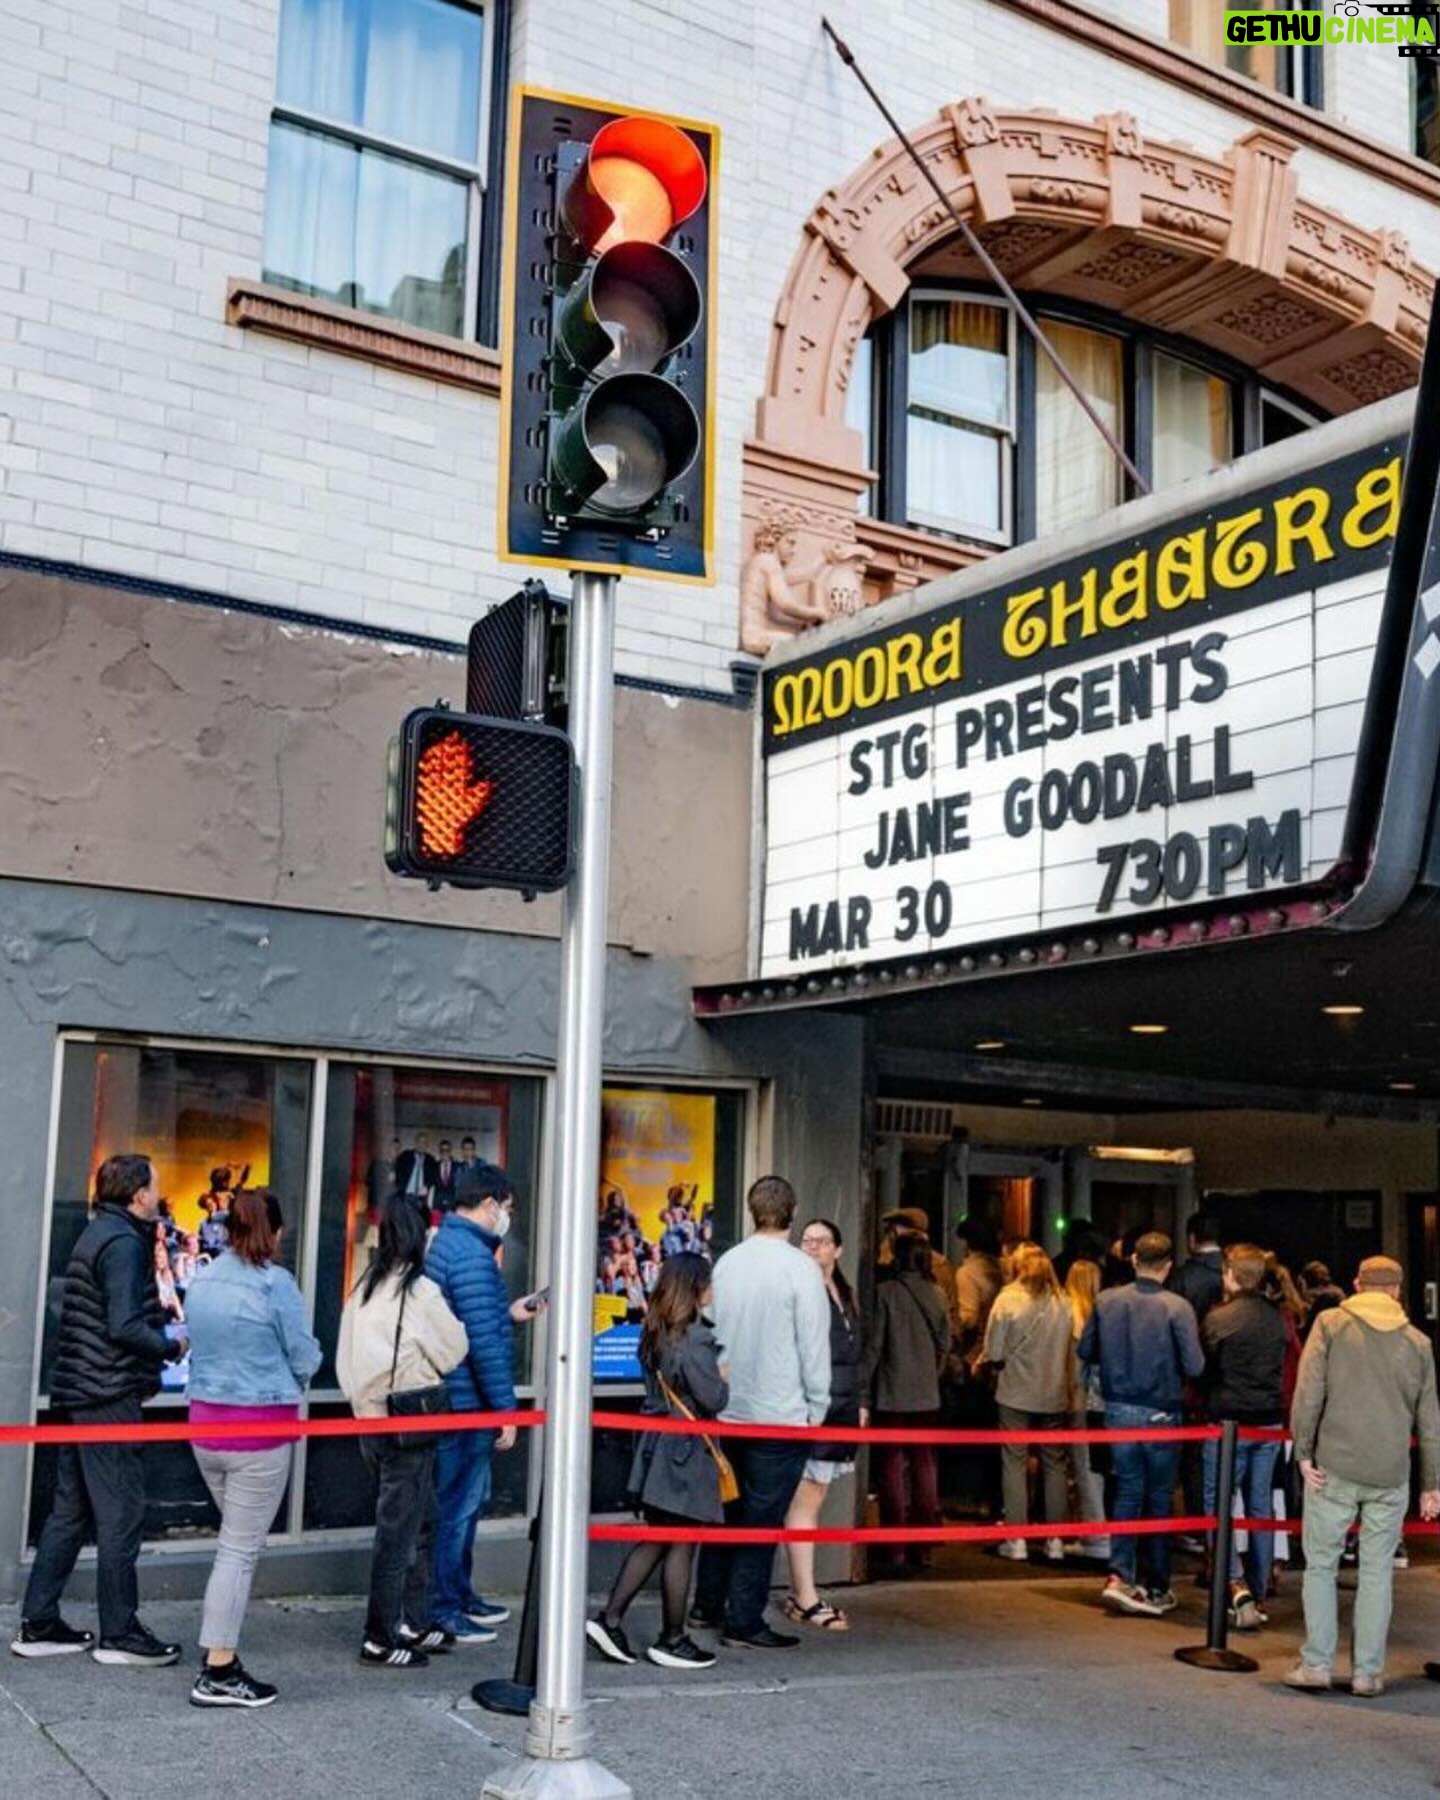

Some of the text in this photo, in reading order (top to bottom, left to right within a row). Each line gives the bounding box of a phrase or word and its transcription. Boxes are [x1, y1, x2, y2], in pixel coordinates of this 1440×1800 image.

[772, 456, 1403, 735] MOORE THEATRE
[848, 632, 1229, 796] STG PRESENTS
[864, 724, 1253, 869] JANE GOODALL
[788, 894, 873, 961] MAR
[893, 879, 953, 941] 30
